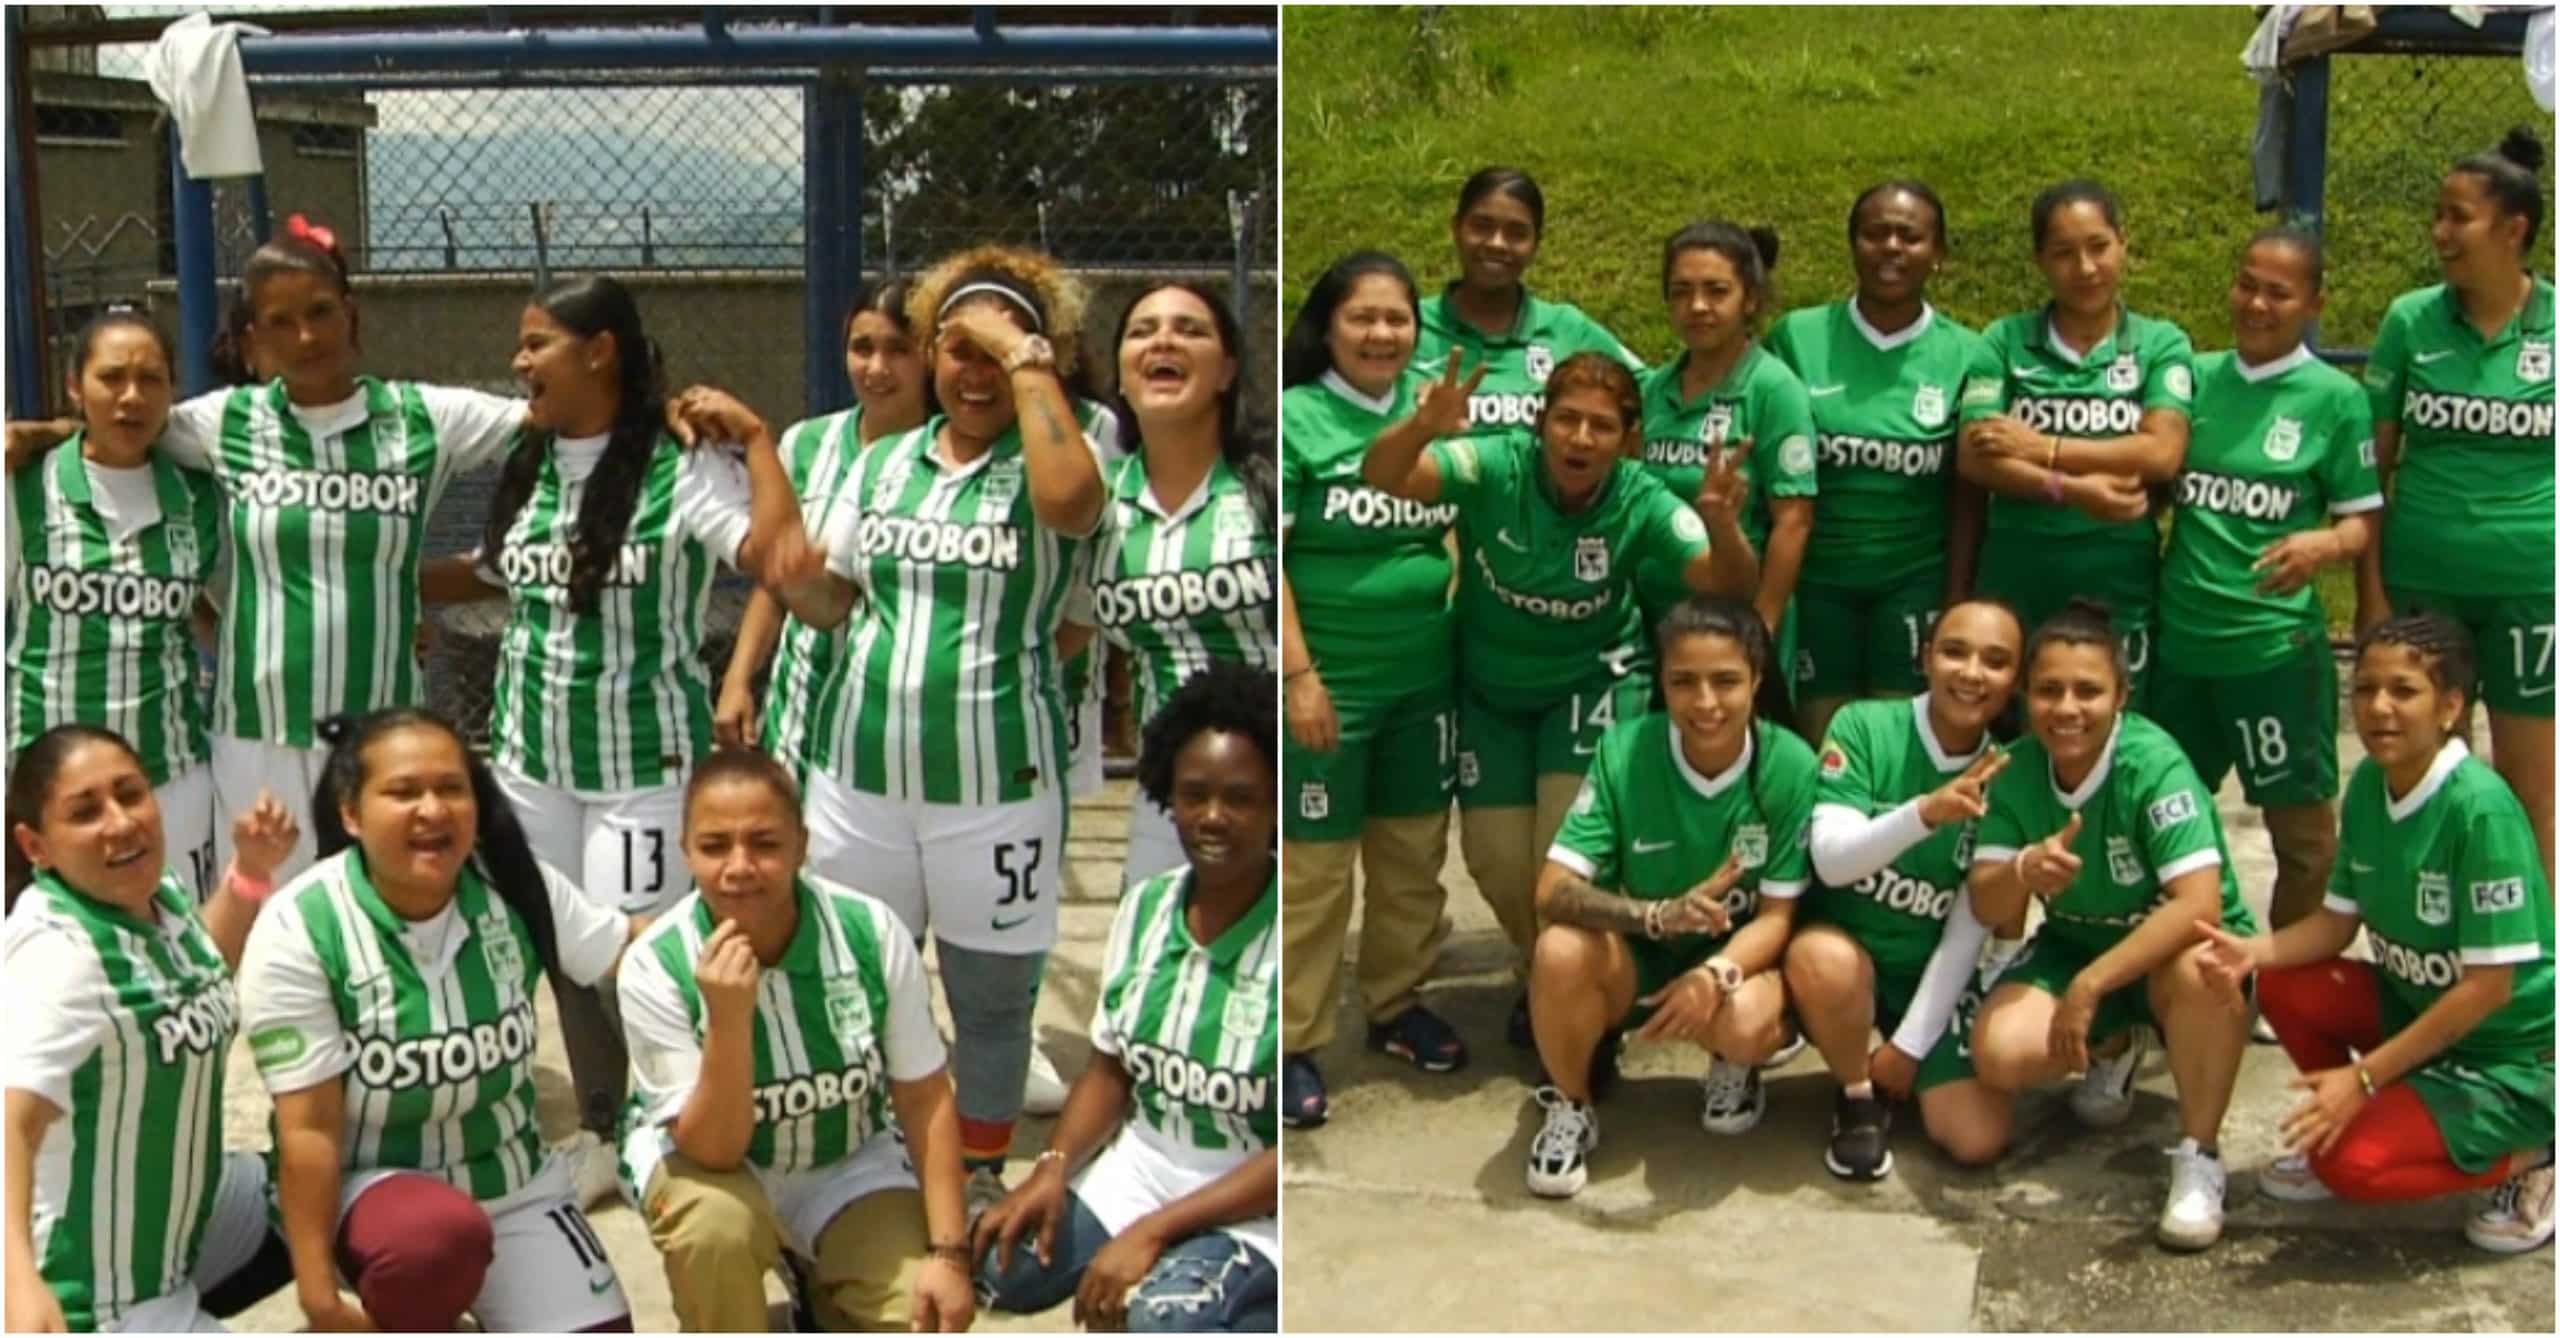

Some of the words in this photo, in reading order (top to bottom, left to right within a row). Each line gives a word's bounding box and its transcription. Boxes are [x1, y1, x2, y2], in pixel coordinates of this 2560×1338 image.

[1467, 393, 1546, 425] TOBO
[2402, 390, 2554, 437] POSTOBON
[1816, 433, 1943, 477] OSTOBON
[2182, 471, 2294, 521] STOBON
[860, 512, 1018, 570] OSTOBON
[1096, 560, 1272, 626] OSTOBON
[2508, 625, 2555, 679] 17
[1569, 686, 1615, 734] 14
[2234, 715, 2288, 770] 18
[621, 828, 665, 894] 13
[993, 837, 1043, 906] 52
[2475, 882, 2519, 909] FCF
[751, 1044, 883, 1122] STOBON
[544, 1203, 608, 1270] 10
